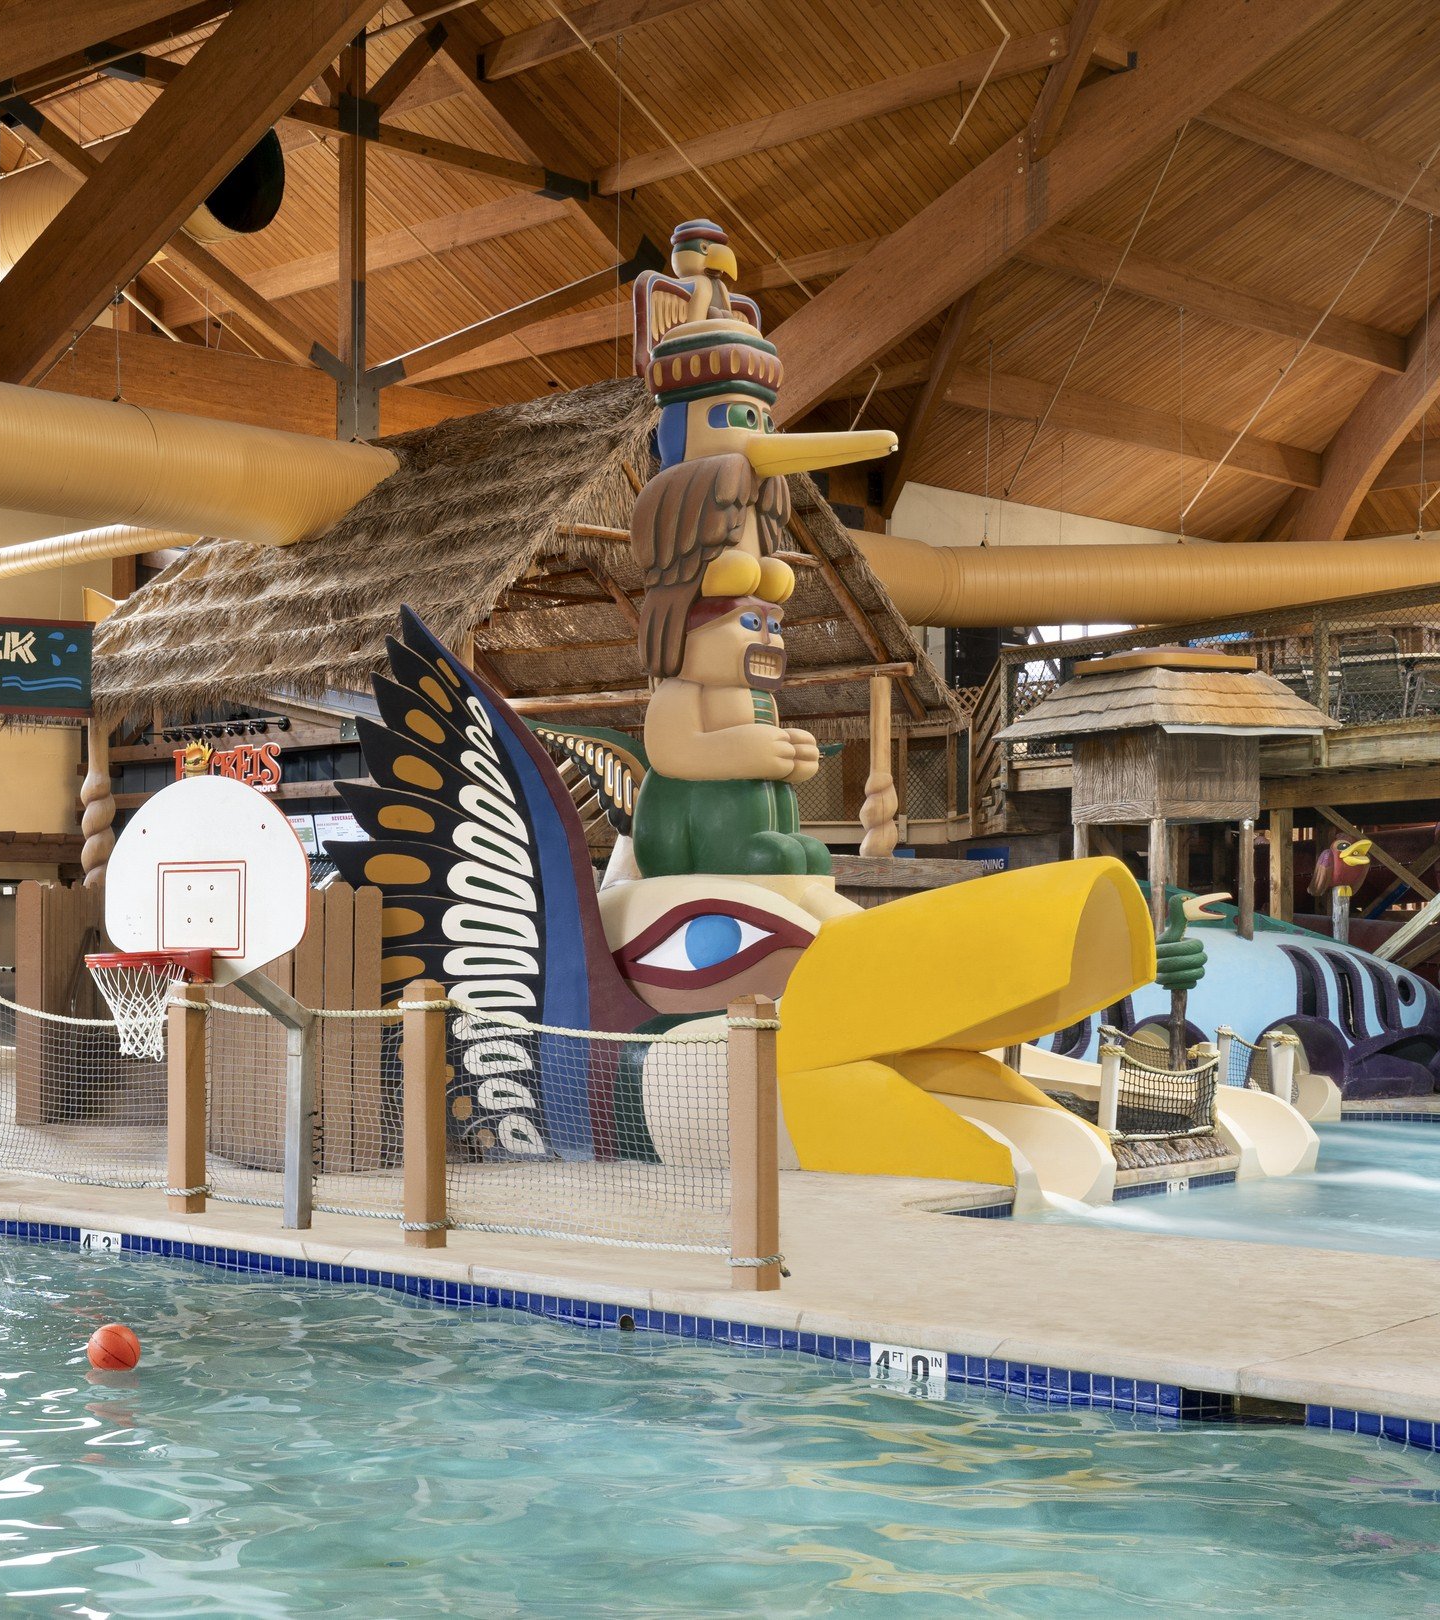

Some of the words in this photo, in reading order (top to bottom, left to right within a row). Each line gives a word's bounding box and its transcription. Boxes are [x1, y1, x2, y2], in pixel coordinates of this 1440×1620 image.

[173, 742, 281, 785] CKETS
[892, 1352, 904, 1363] FT
[931, 1357, 942, 1368] IN
